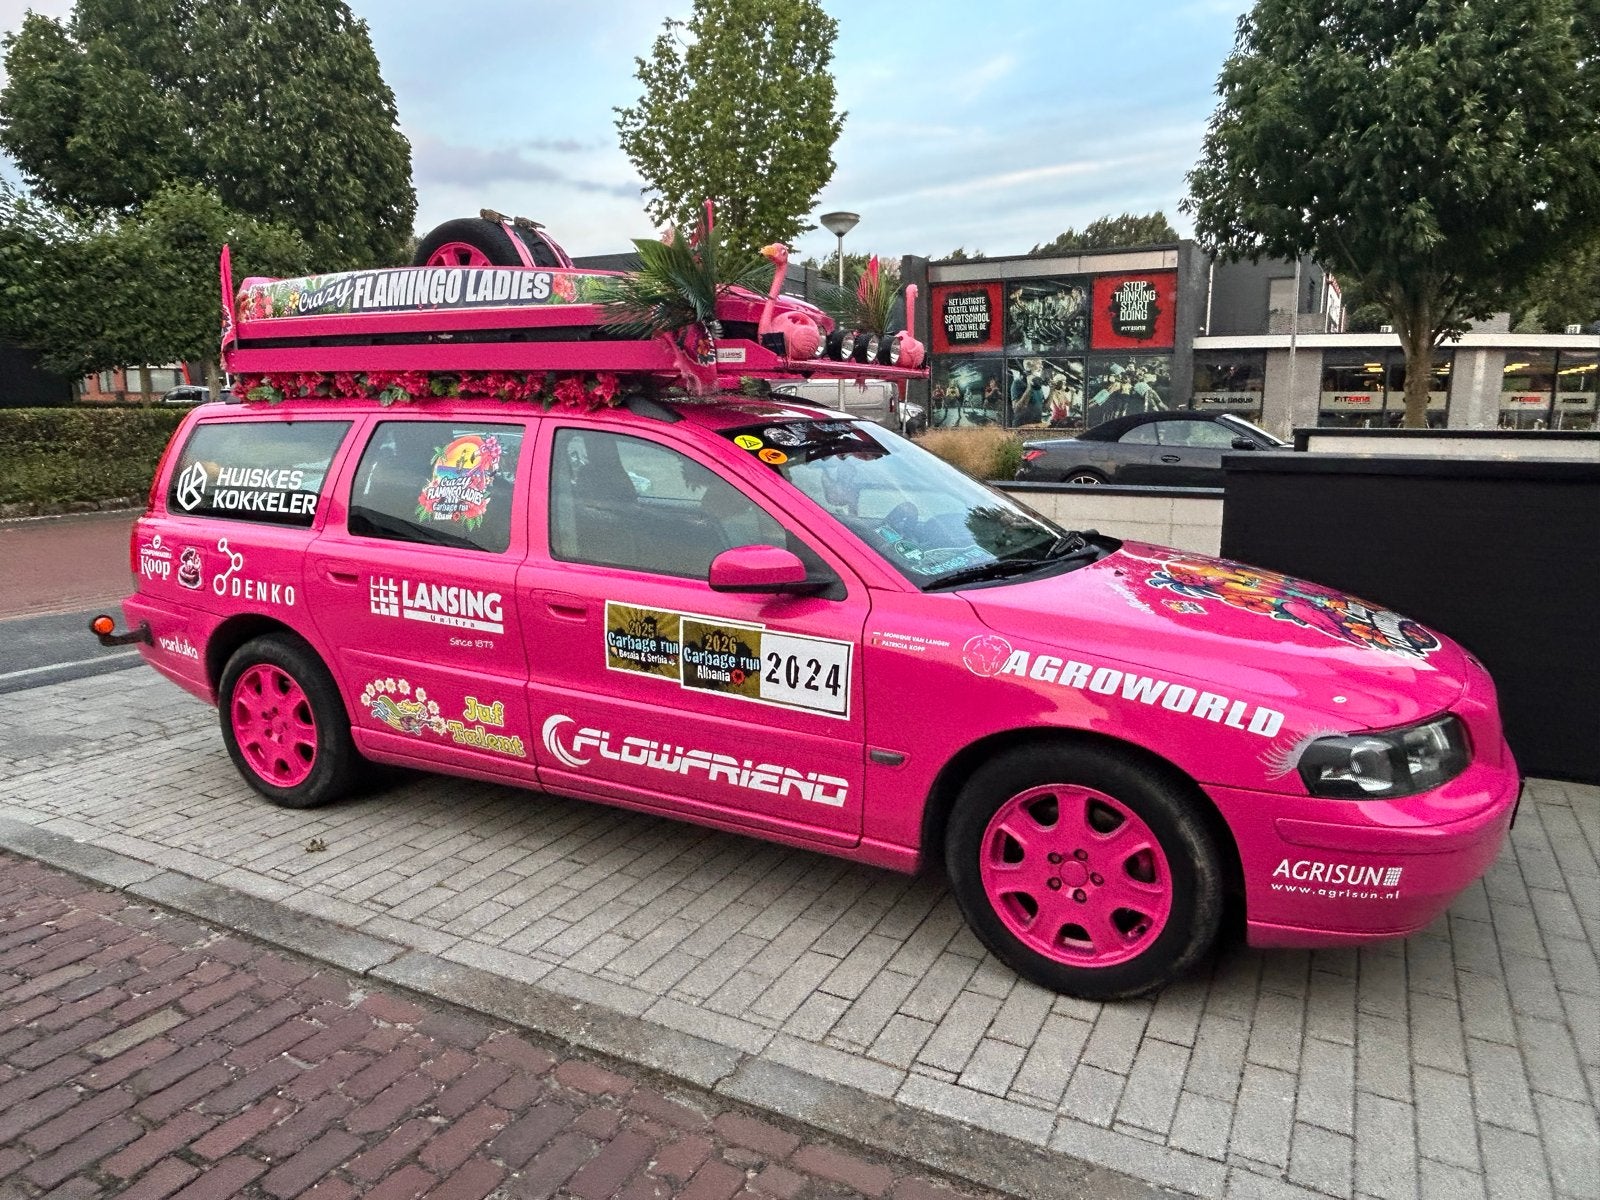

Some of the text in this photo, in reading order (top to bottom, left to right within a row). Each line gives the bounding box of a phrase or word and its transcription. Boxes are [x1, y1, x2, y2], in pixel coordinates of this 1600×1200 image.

[298, 268, 551, 313] Crazy FLAMINGO LADIES
[1114, 290, 1156, 302] THINKING
[1123, 281, 1147, 292] STOP
[959, 296, 986, 305] LASTIGSTE
[969, 304, 979, 312] VAN
[1120, 300, 1149, 311] START
[944, 312, 990, 324] SPORTSCHOOL
[1120, 310, 1148, 321] DOING
[955, 330, 979, 339] DREMPEL
[216, 467, 304, 490] HUISKES
[212, 489, 318, 515] KOKKELER
[140, 555, 171, 580] Koop
[232, 577, 295, 606] DENKO
[402, 579, 503, 622] LANSING
[628, 620, 655, 639] 2025
[449, 637, 473, 647] Since
[607, 631, 679, 655] Carbage run
[704, 633, 737, 655] 2026
[647, 653, 668, 664] Serbia
[683, 648, 761, 671] Carbage run
[696, 665, 731, 683] Albania
[765, 652, 841, 697] 2024
[1000, 649, 1285, 738] AGROWORLD
[463, 696, 504, 727] Juf
[447, 720, 527, 757] Talent
[572, 727, 849, 808] FLOWFRIEND
[1272, 858, 1384, 887] AGRISUN
[1270, 883, 1400, 899] www.agrisun.nl
